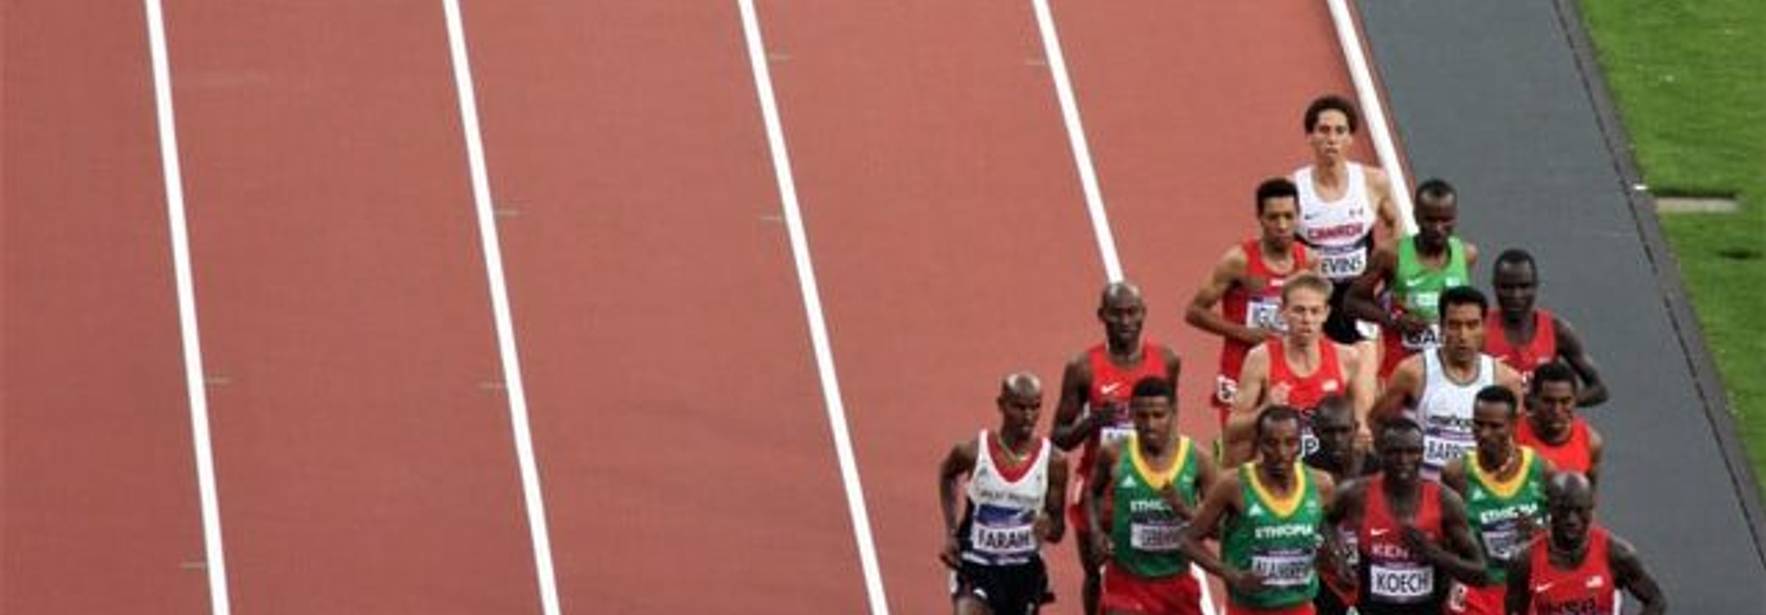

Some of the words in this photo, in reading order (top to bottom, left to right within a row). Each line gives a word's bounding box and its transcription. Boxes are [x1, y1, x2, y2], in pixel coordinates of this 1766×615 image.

[977, 529, 1031, 549] FARAH
[1255, 525, 1313, 538] ETHIOPIA
[1376, 572, 1430, 593] KOECH
